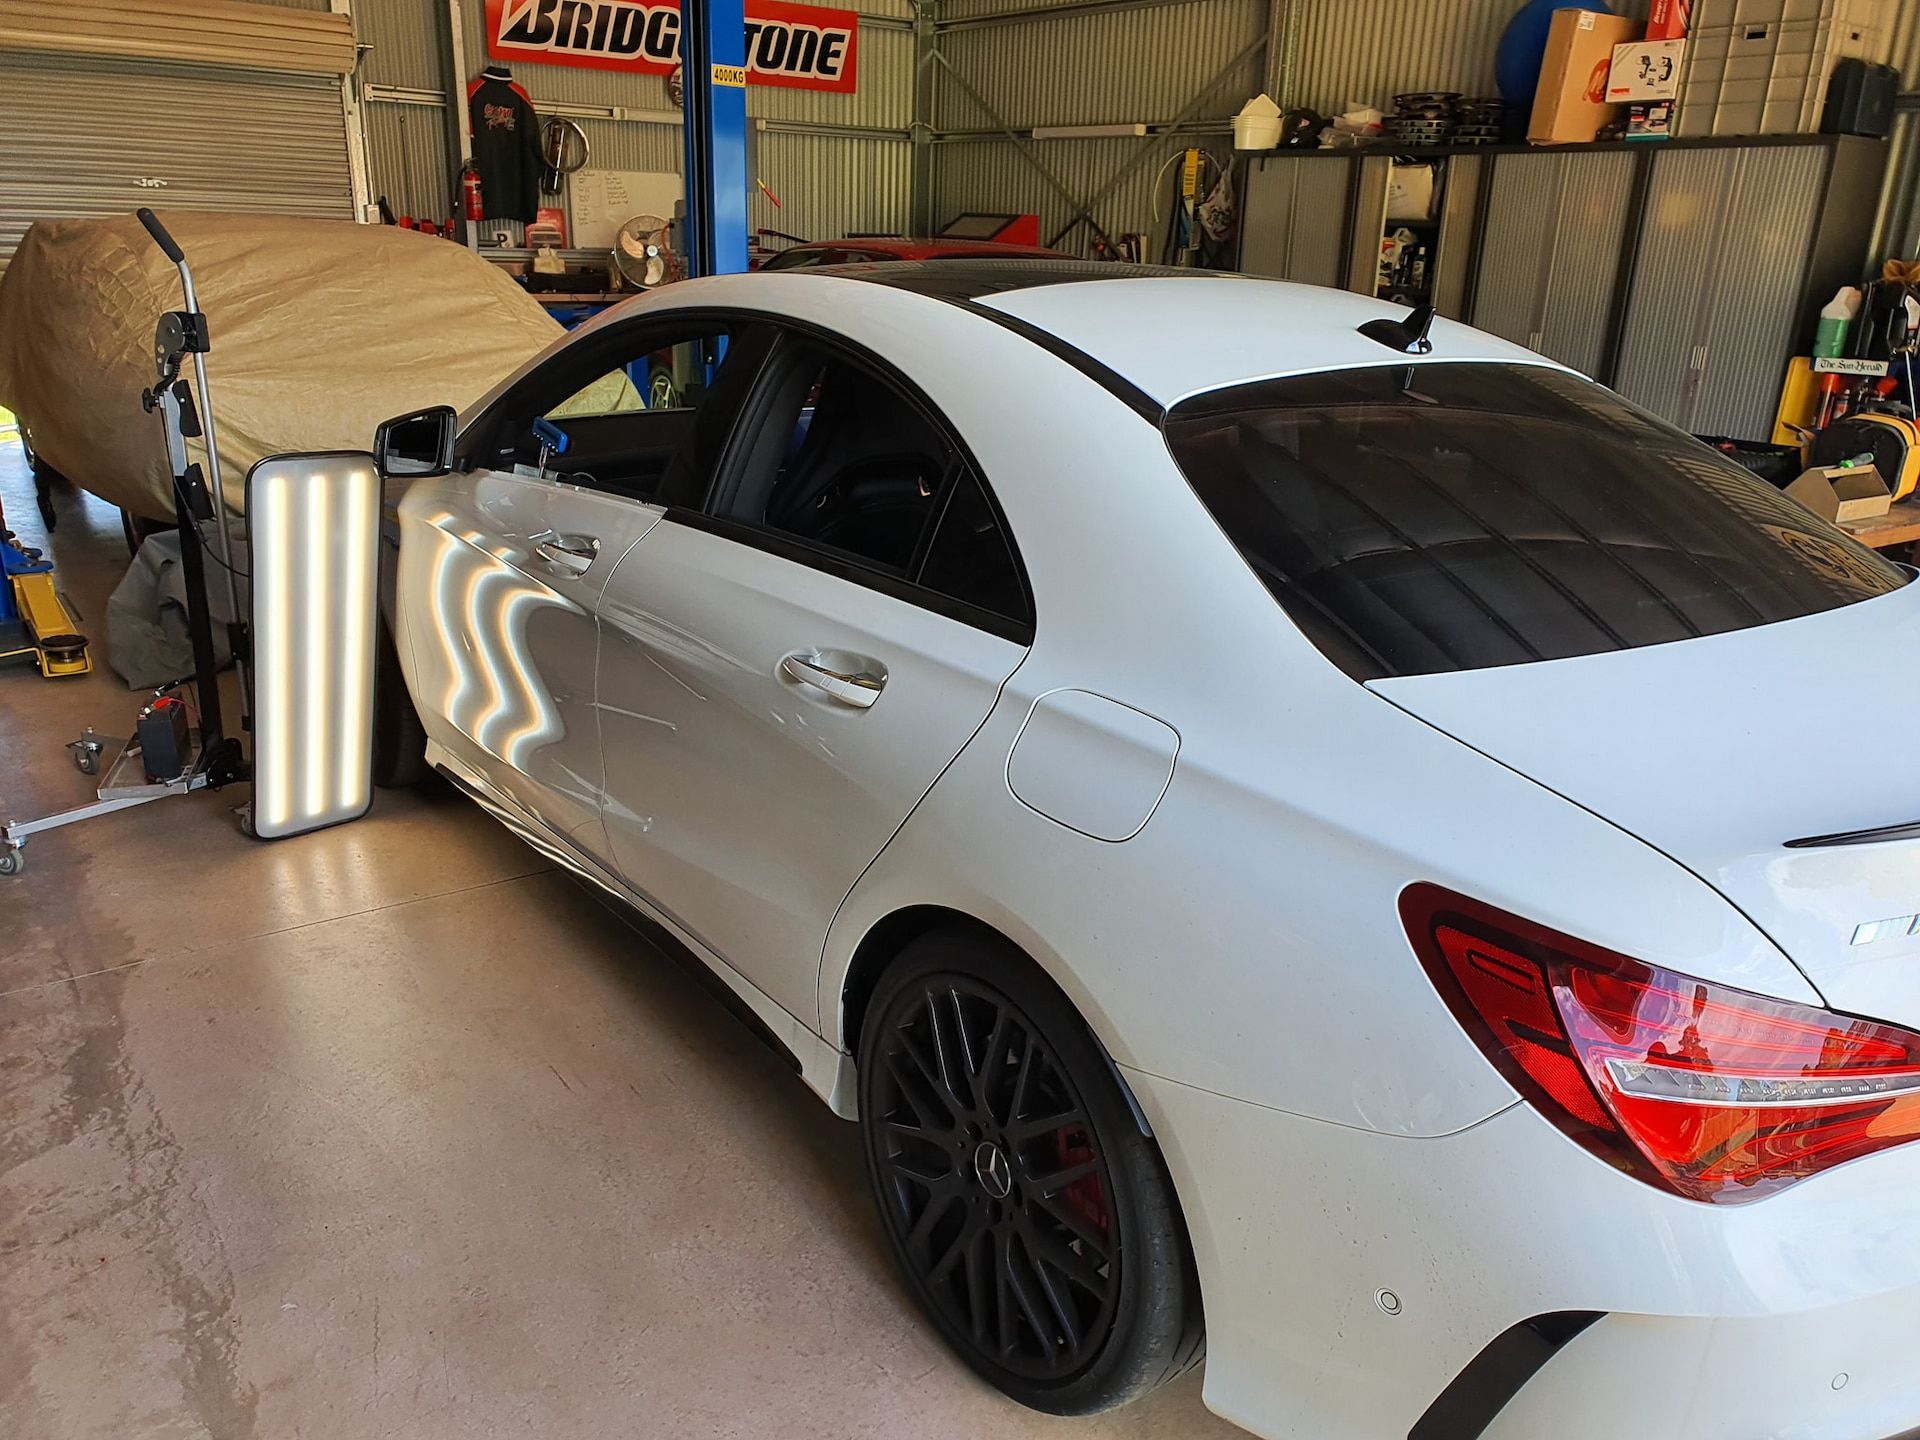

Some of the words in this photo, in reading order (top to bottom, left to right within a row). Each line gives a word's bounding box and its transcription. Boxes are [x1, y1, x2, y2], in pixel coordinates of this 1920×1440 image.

[499, 0, 846, 76] BRIDGTONE
[714, 68, 744, 83] 4000KG
[1820, 359, 1835, 369] The
[1838, 360, 1854, 369] Sun
[1855, 361, 1883, 372] Herald
